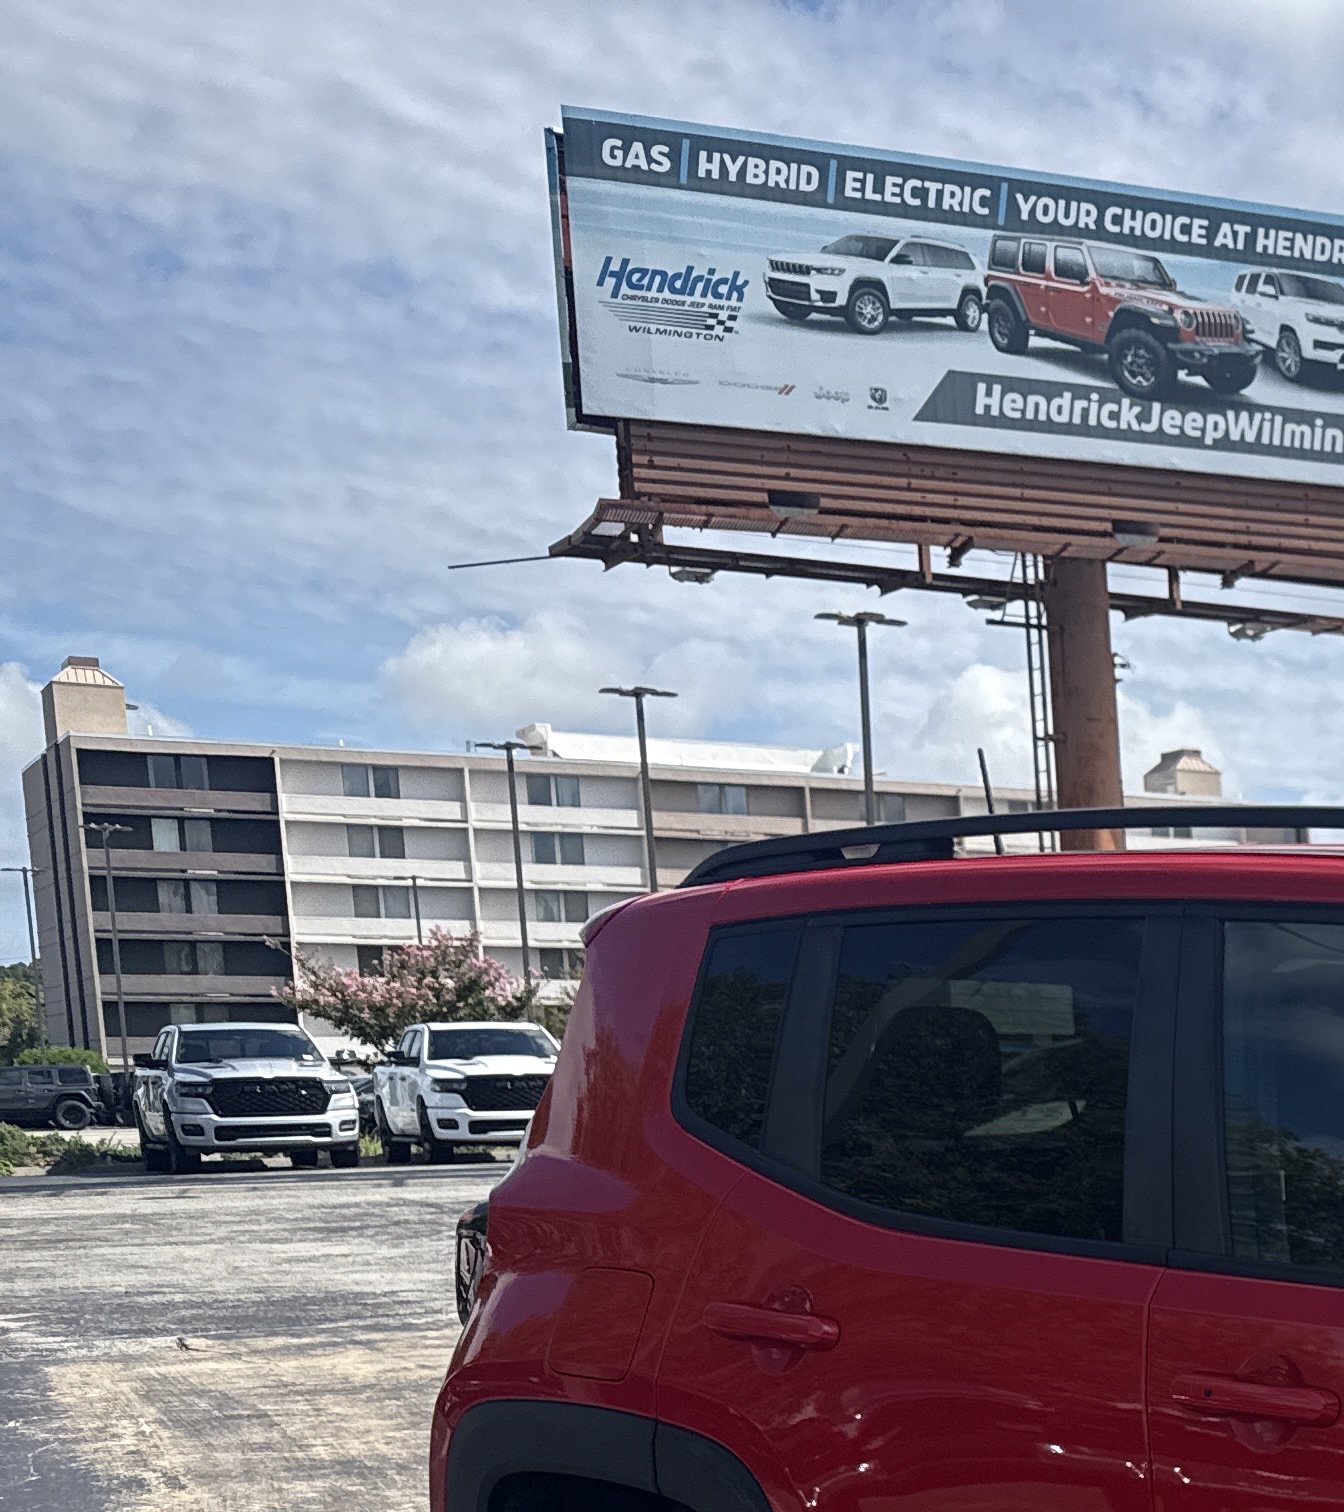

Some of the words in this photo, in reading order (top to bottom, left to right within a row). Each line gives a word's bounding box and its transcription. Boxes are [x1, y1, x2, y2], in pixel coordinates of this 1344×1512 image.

[601, 138, 672, 173] GAS
[698, 150, 819, 192] HYBRID
[844, 170, 991, 216] ELECTRIC
[1015, 193, 1098, 230] YOUR
[1104, 206, 1208, 245] CHOICE
[1214, 222, 1251, 251] AT
[596, 256, 749, 302] Hendrick
[628, 324, 725, 342] WILMINGTON
